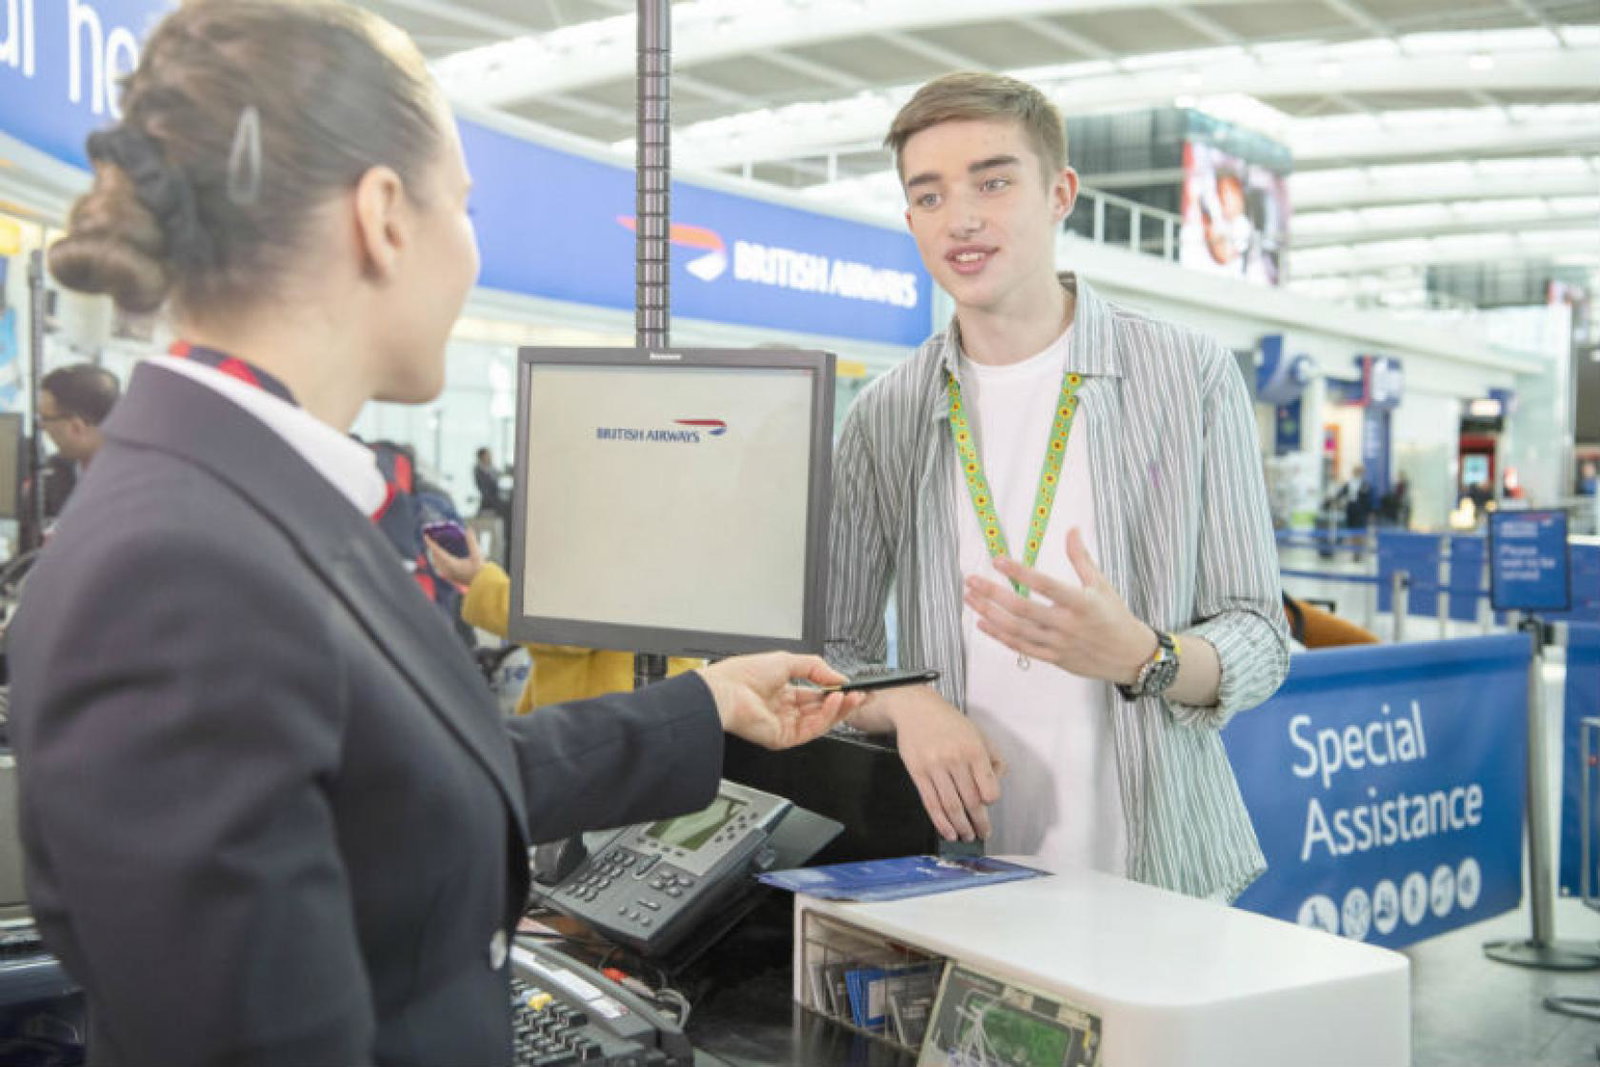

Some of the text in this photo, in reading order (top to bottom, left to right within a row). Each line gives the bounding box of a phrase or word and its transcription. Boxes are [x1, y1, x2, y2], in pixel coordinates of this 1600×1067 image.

[733, 240, 917, 309] BRITISH AIRWAYS
[596, 427, 700, 443] BRITISH AIRWAYS
[1288, 700, 1427, 790] Special
[1301, 784, 1484, 862] Assistance
